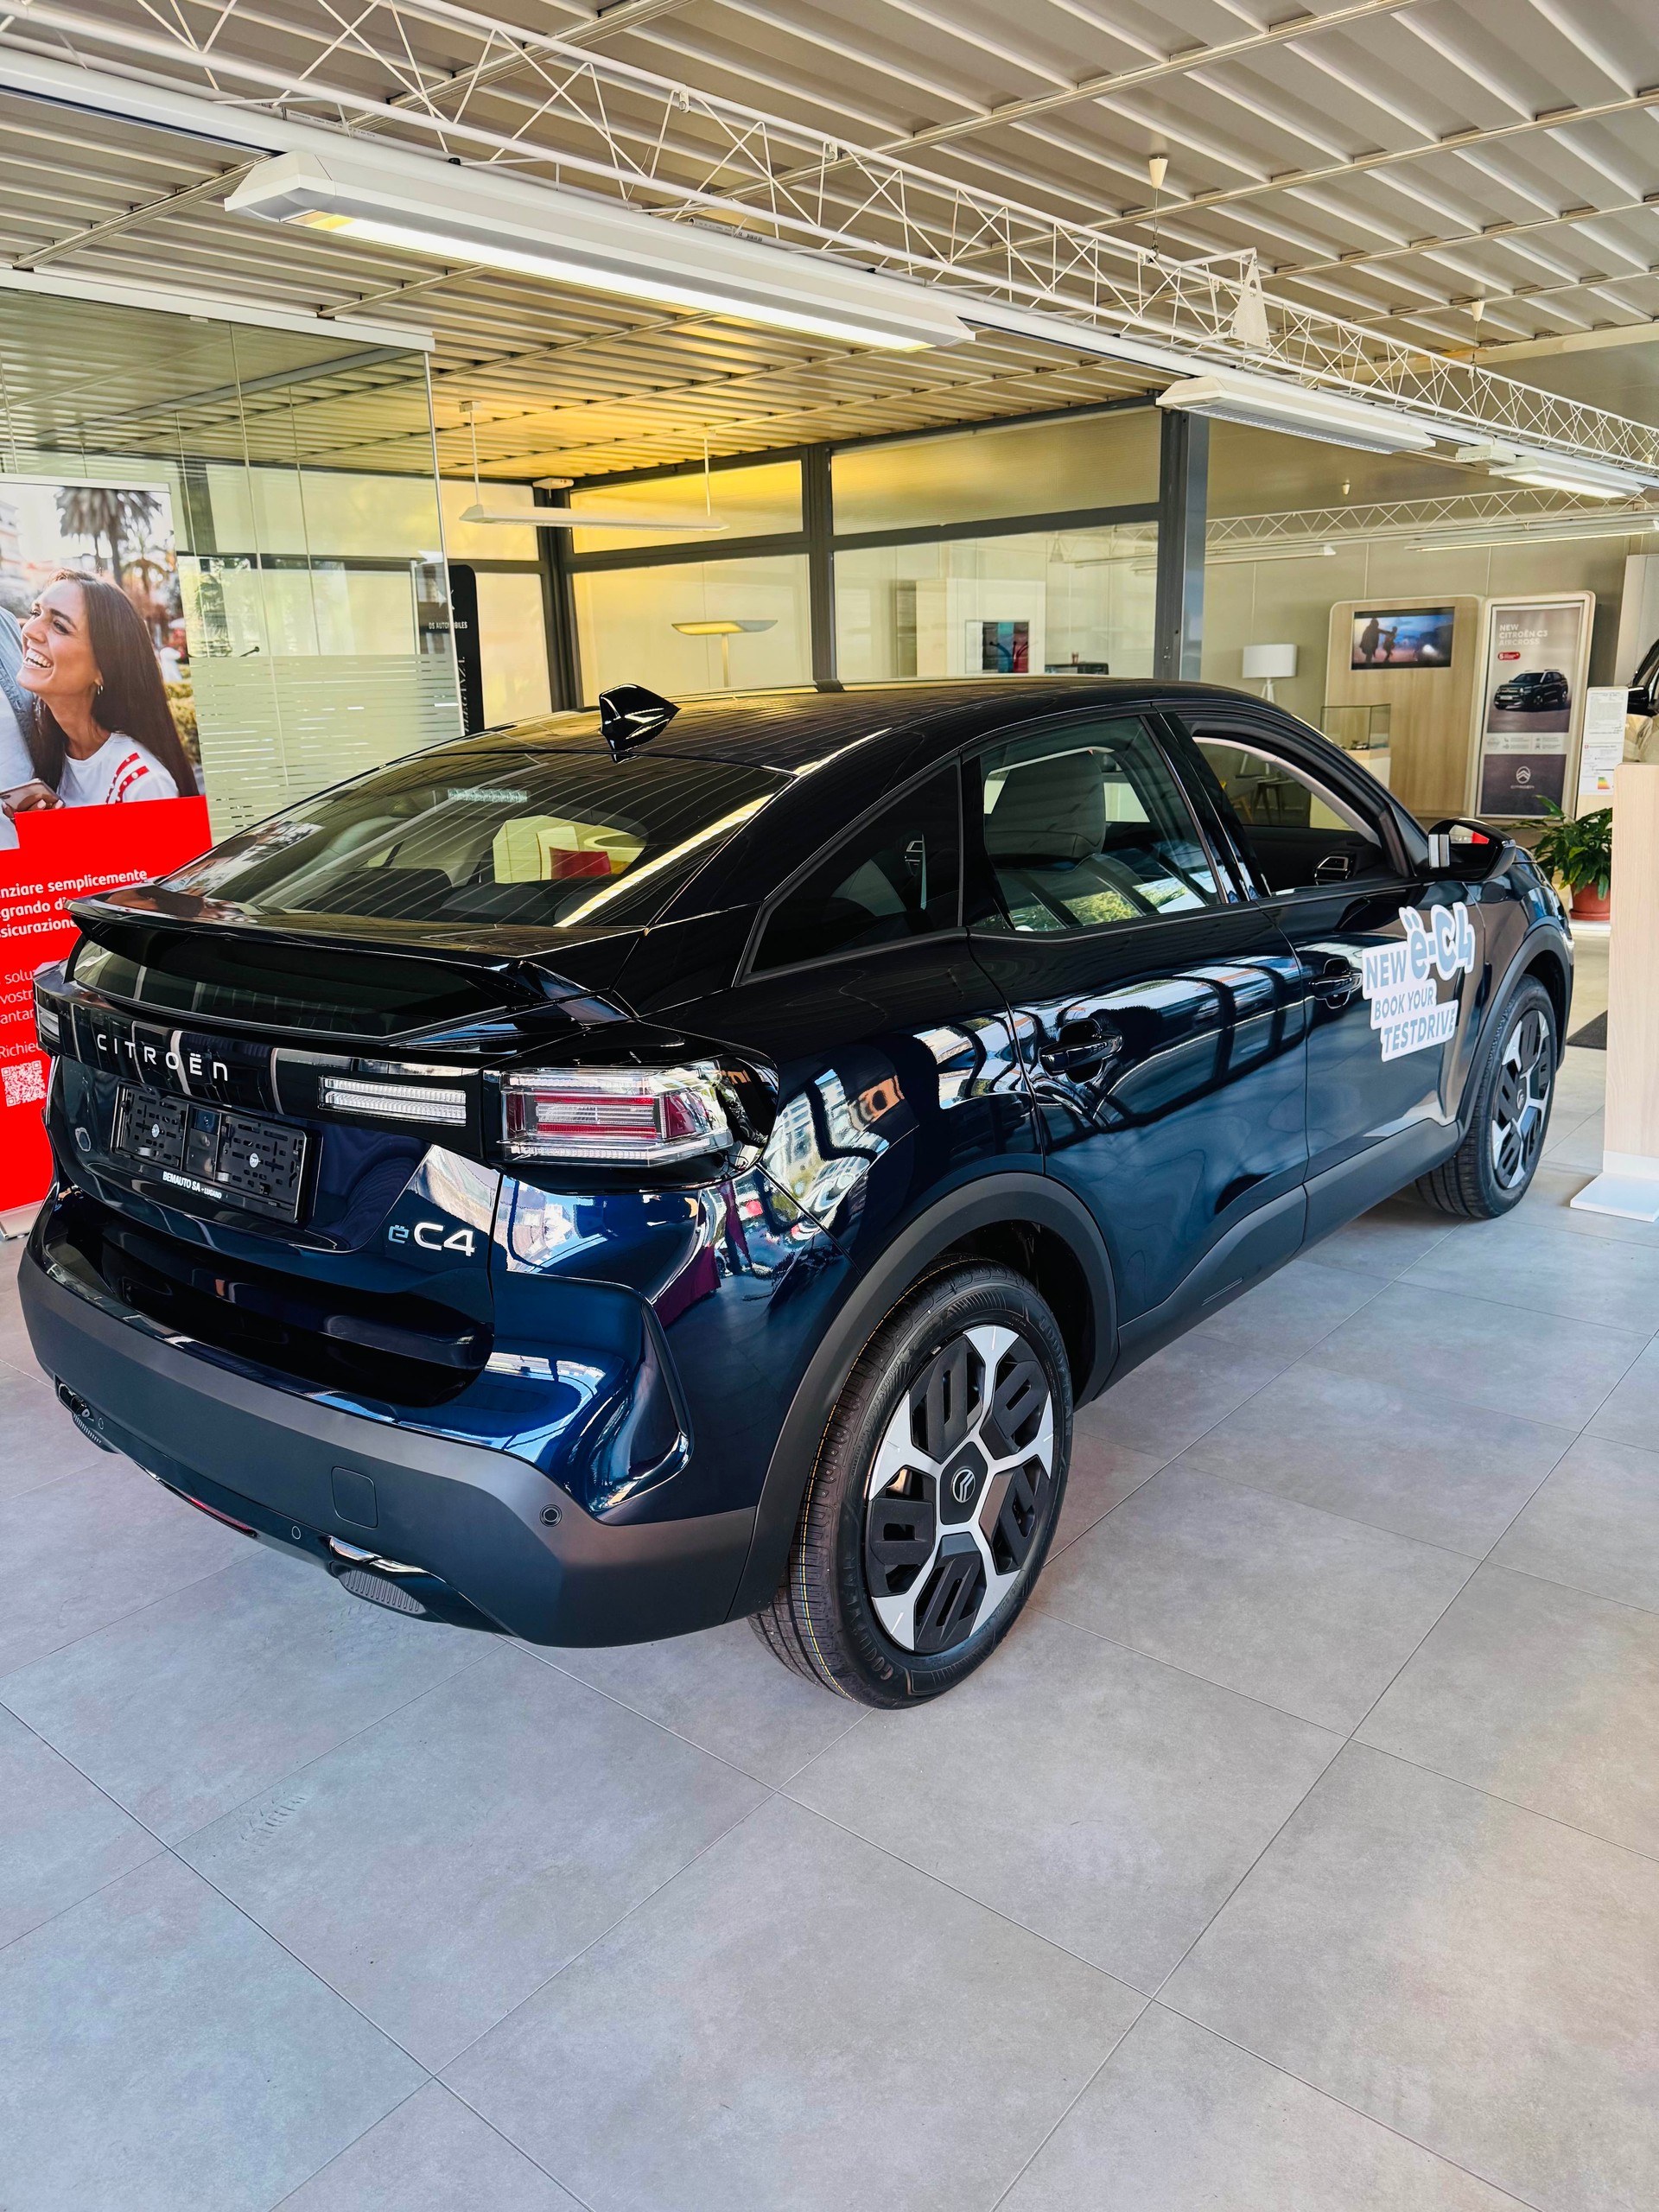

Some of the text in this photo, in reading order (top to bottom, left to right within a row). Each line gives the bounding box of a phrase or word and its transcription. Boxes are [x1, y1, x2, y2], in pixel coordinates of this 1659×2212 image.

[1499, 623, 1519, 632] NEW
[1499, 629, 1548, 639] CITROËN C3
[1498, 638, 1540, 646] AIRCROSS
[0, 868, 148, 899] nziare semplicemente
[0, 898, 50, 922] grando
[0, 917, 78, 938] sicurazione
[4, 969, 35, 984] solu
[1366, 950, 1407, 991] NEW
[0, 988, 34, 1004] vostr
[1375, 987, 1433, 1020] BOOK YOUR
[0, 1008, 35, 1025] antar
[1383, 1007, 1456, 1053] TESTDRIVE
[162, 1171, 192, 1189] BEMAUTO
[192, 1180, 200, 1192] SA
